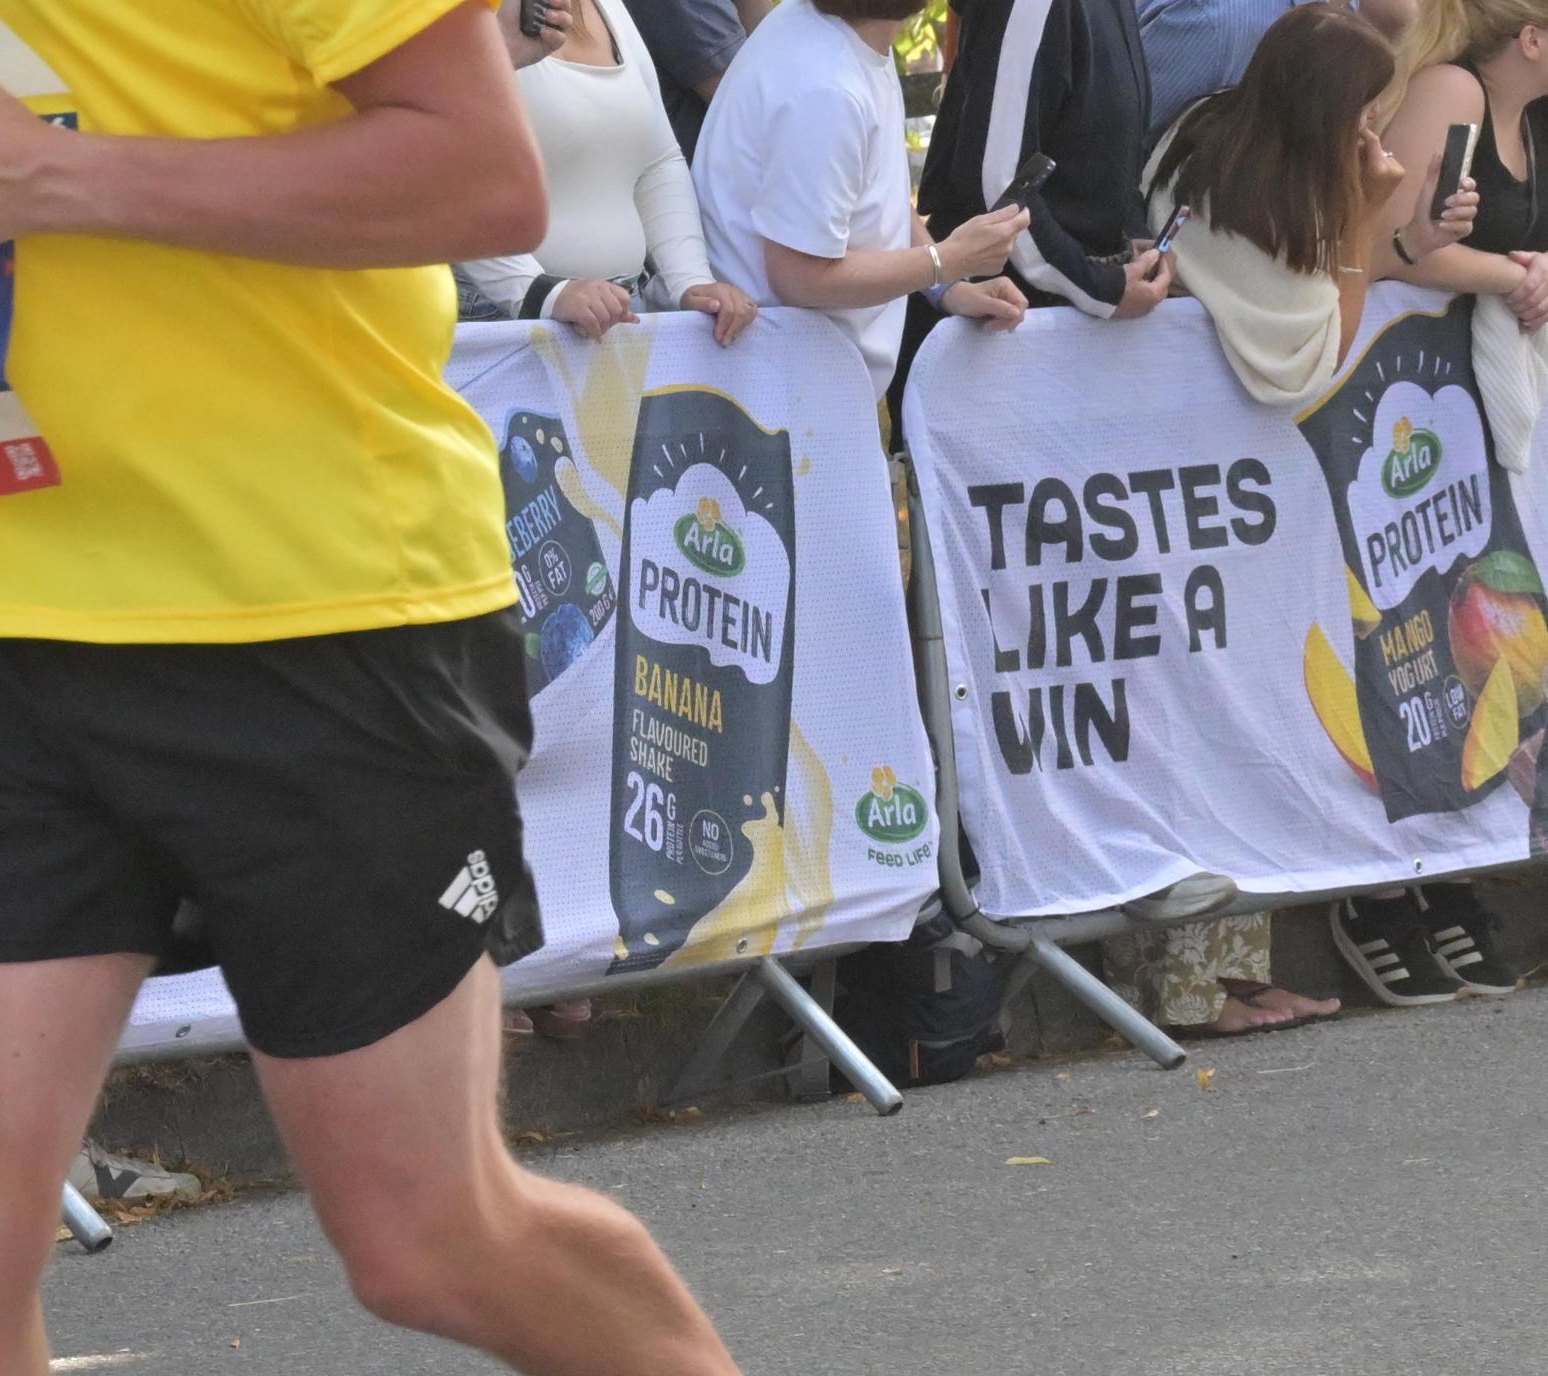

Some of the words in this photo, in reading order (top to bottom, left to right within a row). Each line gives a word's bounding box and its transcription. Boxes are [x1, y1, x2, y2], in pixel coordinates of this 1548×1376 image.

[1390, 442, 1432, 489] Arla
[507, 486, 562, 562] EBERRY
[967, 458, 1276, 570] TASTES
[1366, 474, 1484, 588] PROTEIN
[544, 547, 559, 569] 0%
[683, 522, 734, 566] Arla
[547, 561, 568, 590] FAT
[639, 558, 773, 663] PROTEIN
[981, 573, 1163, 673] LIKE
[1184, 565, 1227, 652] A
[1380, 609, 1435, 666] MANGO
[634, 654, 723, 733] BANANA
[1388, 650, 1439, 696] YOGURT
[1445, 683, 1464, 709] LOW
[991, 678, 1130, 775] WIN
[1453, 706, 1467, 721] FAT
[630, 736, 674, 783] SHAKE
[632, 709, 708, 767] FLAVOURED
[702, 819, 719, 841] NO
[867, 794, 917, 827] Arla
